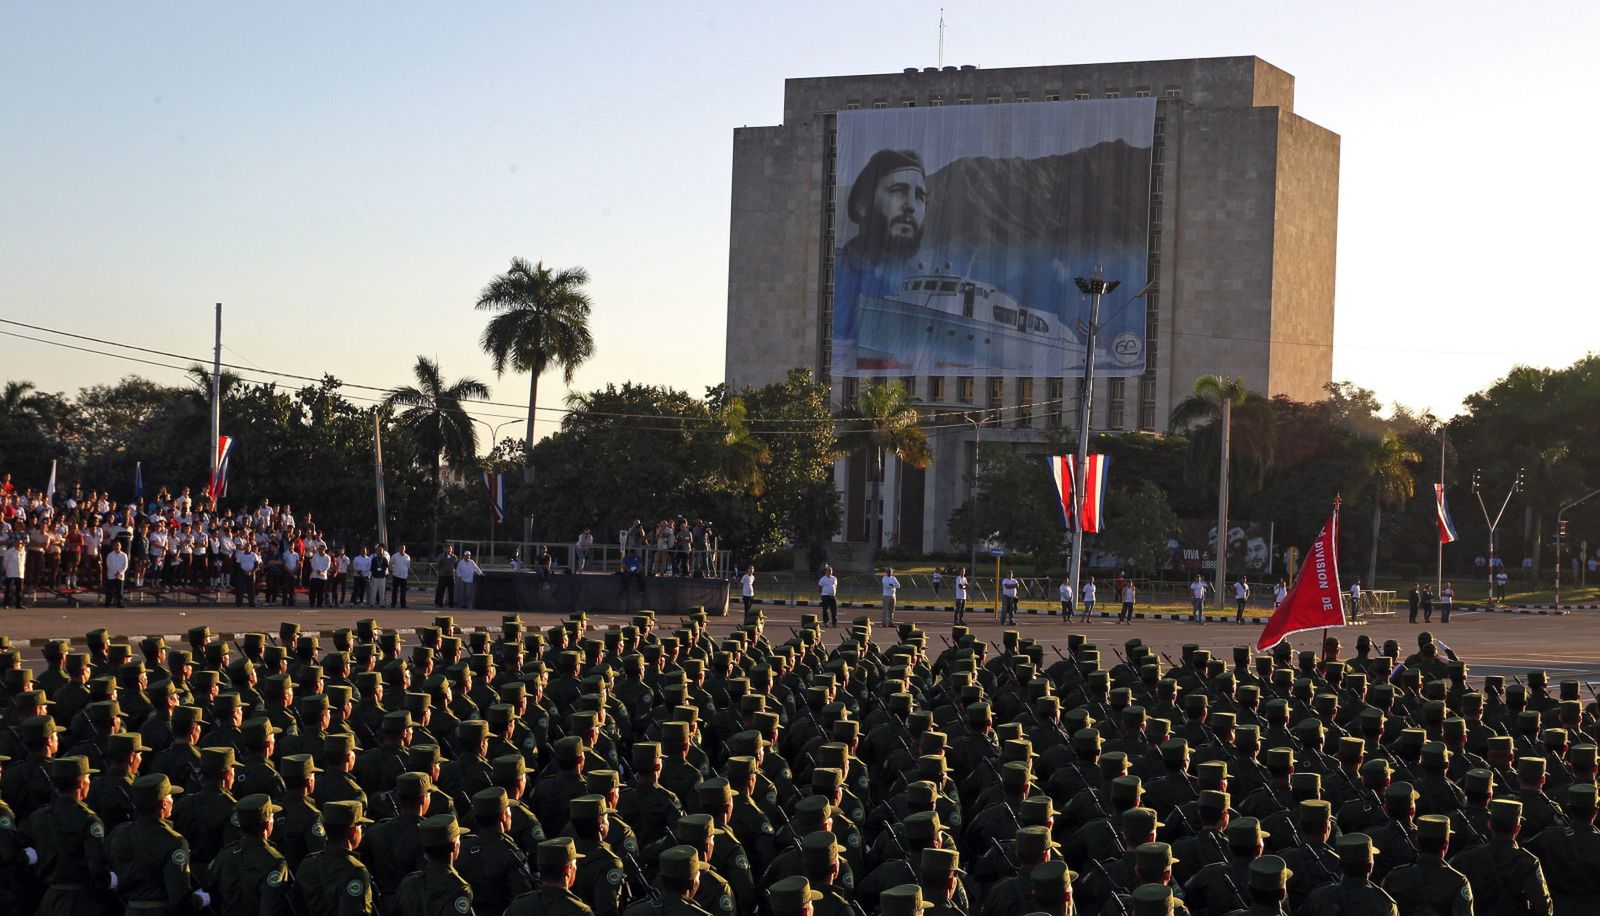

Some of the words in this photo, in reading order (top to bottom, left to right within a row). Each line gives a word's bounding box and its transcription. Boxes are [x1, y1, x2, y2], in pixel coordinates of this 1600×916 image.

[1183, 549, 1200, 560] VIVA
[1314, 541, 1329, 589] DIVISION
[1321, 597, 1333, 611] DE
